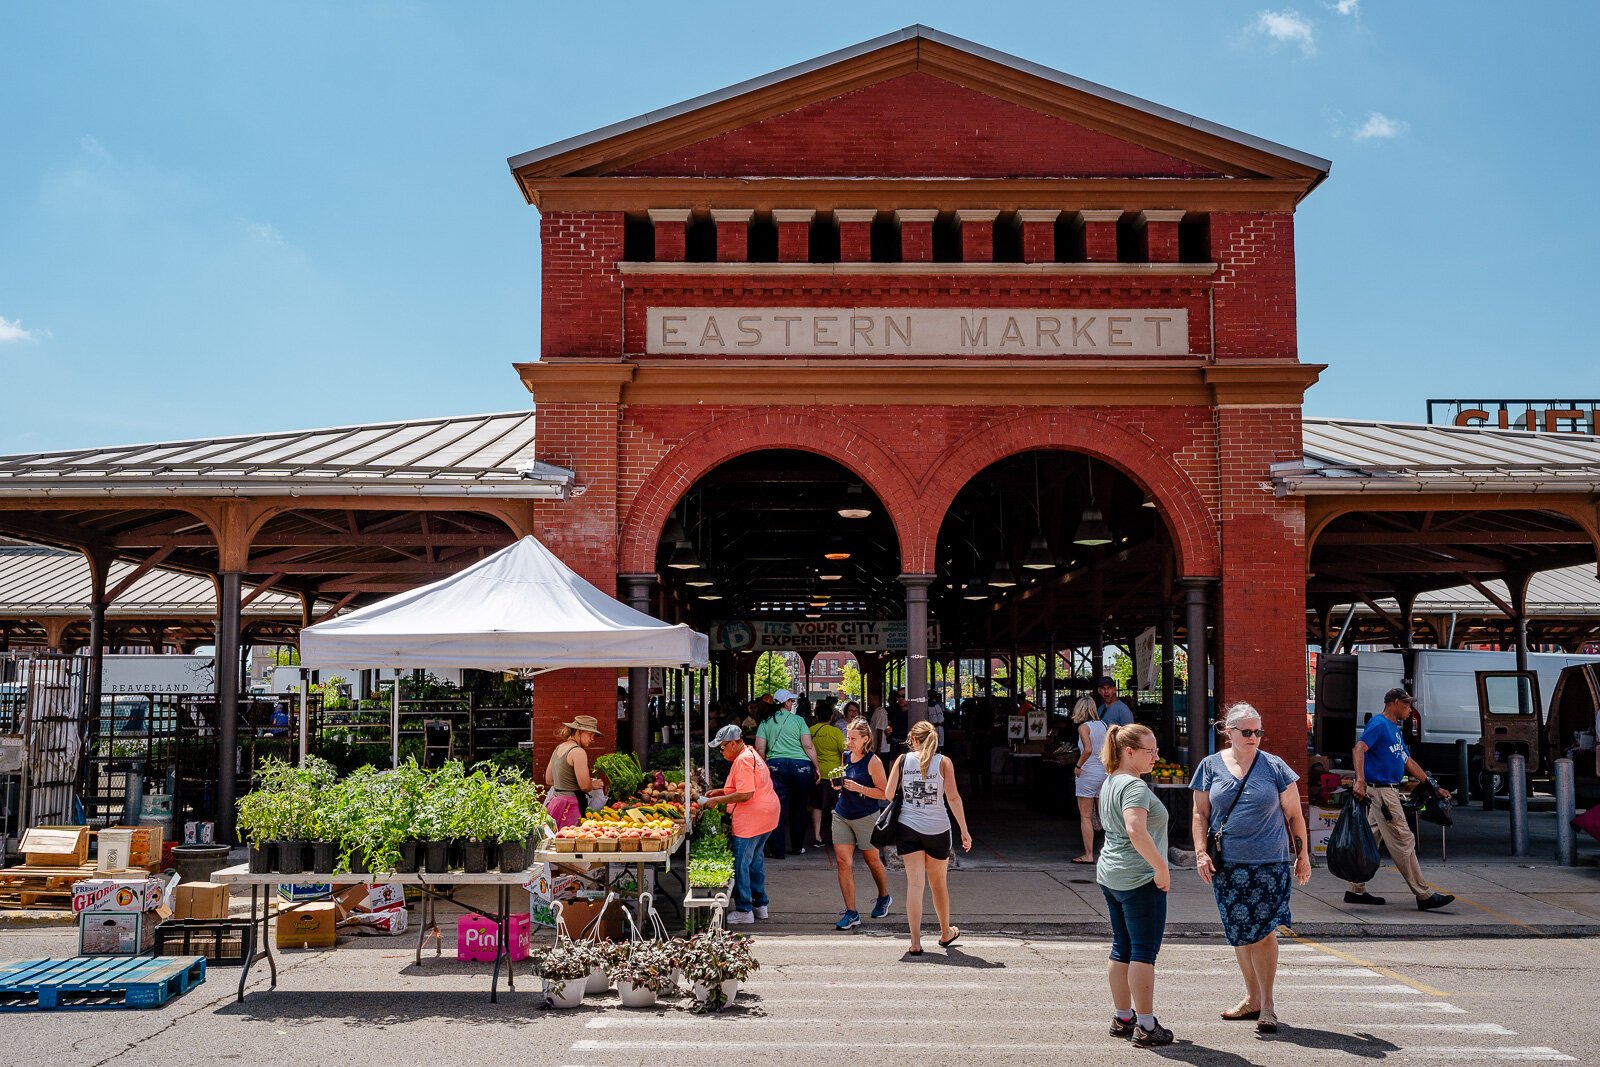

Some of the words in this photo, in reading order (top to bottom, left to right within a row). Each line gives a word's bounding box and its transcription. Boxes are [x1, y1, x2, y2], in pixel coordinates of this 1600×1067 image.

[661, 315, 912, 348] EASTERN
[960, 315, 1172, 348] MARKET
[764, 622, 792, 635] IT'S
[796, 622, 837, 634] YOUR
[841, 621, 876, 634] CITY
[761, 634, 857, 646] EXPERIENCE
[860, 633, 879, 645] IT!
[112, 684, 189, 692] BEAVERLAND
